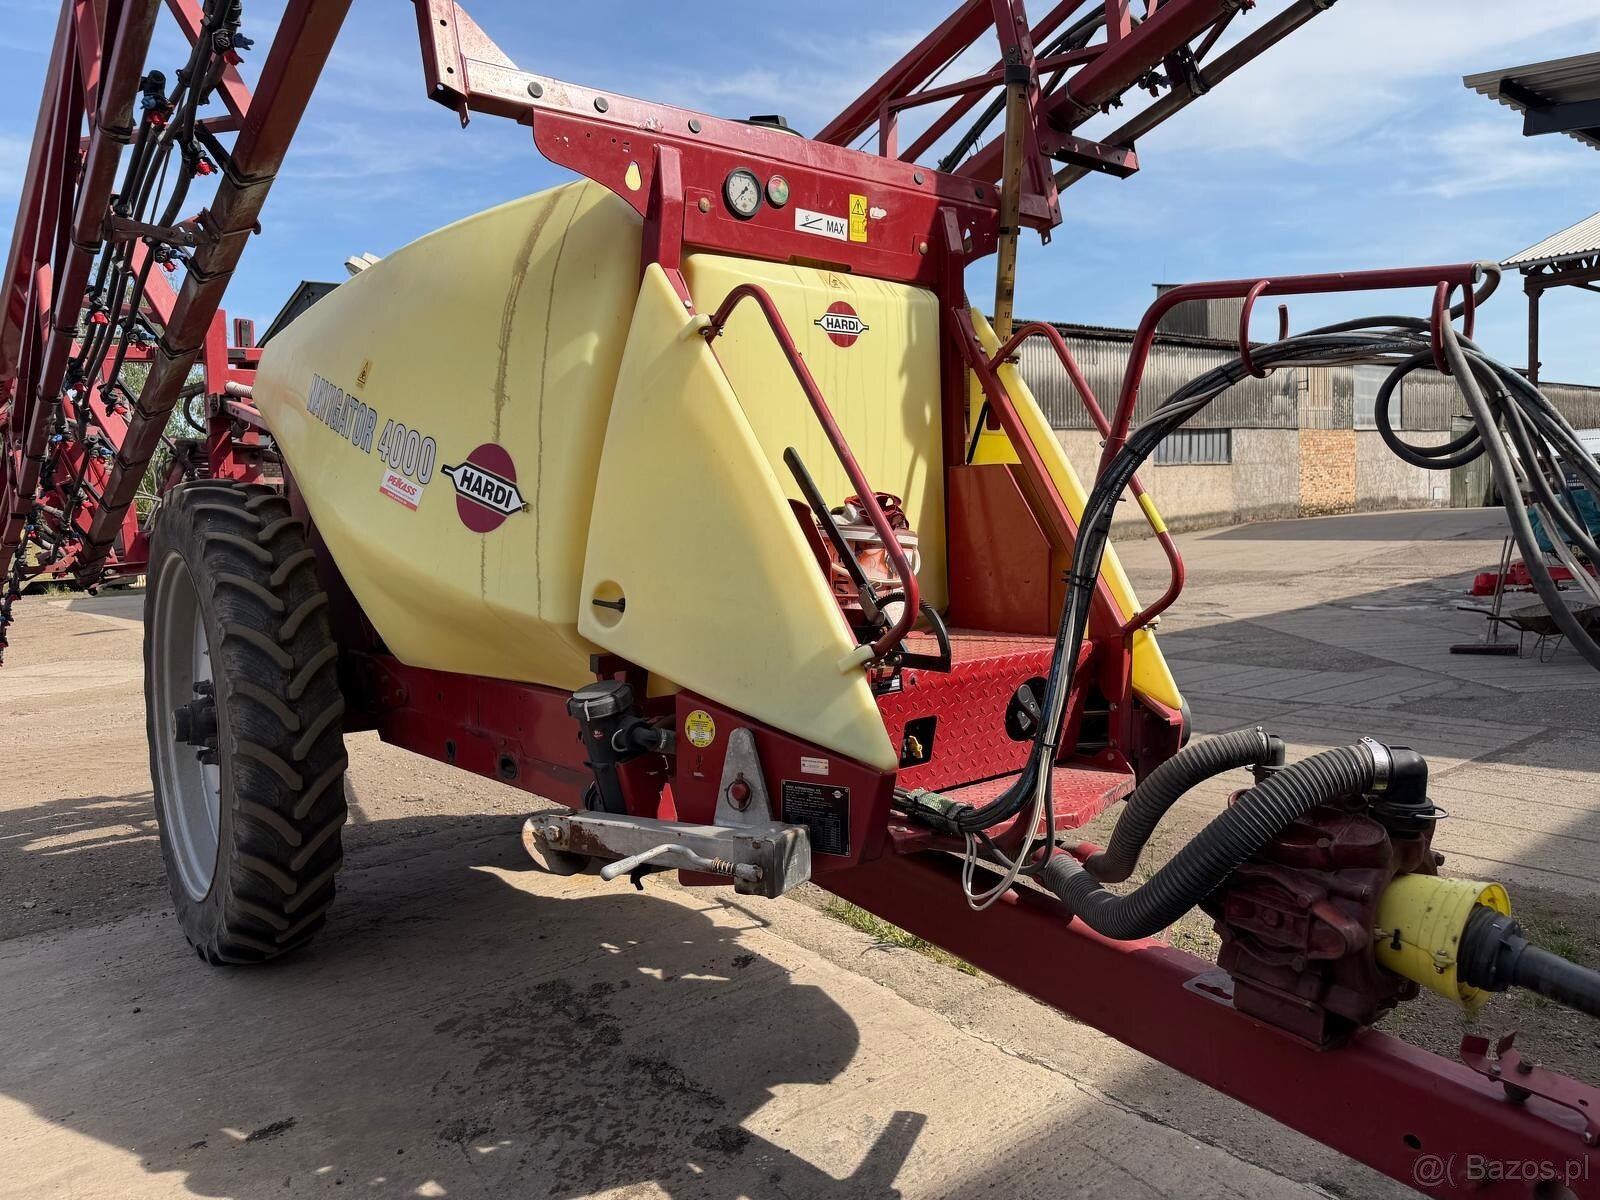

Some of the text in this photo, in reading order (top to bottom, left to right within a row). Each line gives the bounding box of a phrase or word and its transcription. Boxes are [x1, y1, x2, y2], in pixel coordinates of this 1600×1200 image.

[826, 220, 845, 236] MAX
[826, 317, 859, 331] HARDI
[306, 372, 437, 485] NAVIGATOR 4000
[459, 468, 513, 509] HARDI
